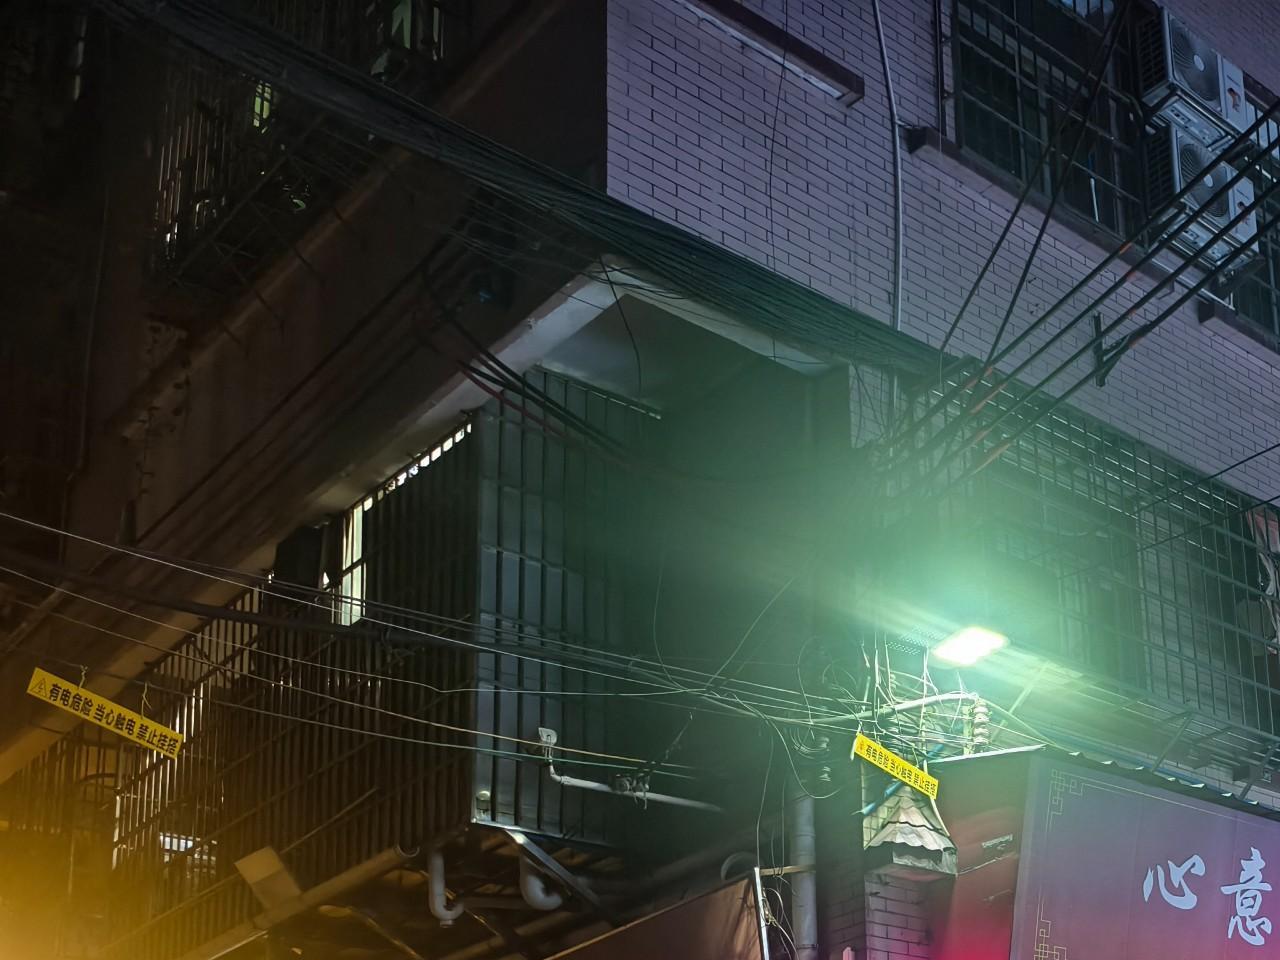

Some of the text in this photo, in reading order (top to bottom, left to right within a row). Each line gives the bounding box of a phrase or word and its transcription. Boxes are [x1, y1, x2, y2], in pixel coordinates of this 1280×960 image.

[50, 683, 93, 716] 有电危险
[93, 704, 136, 736] 当心触电
